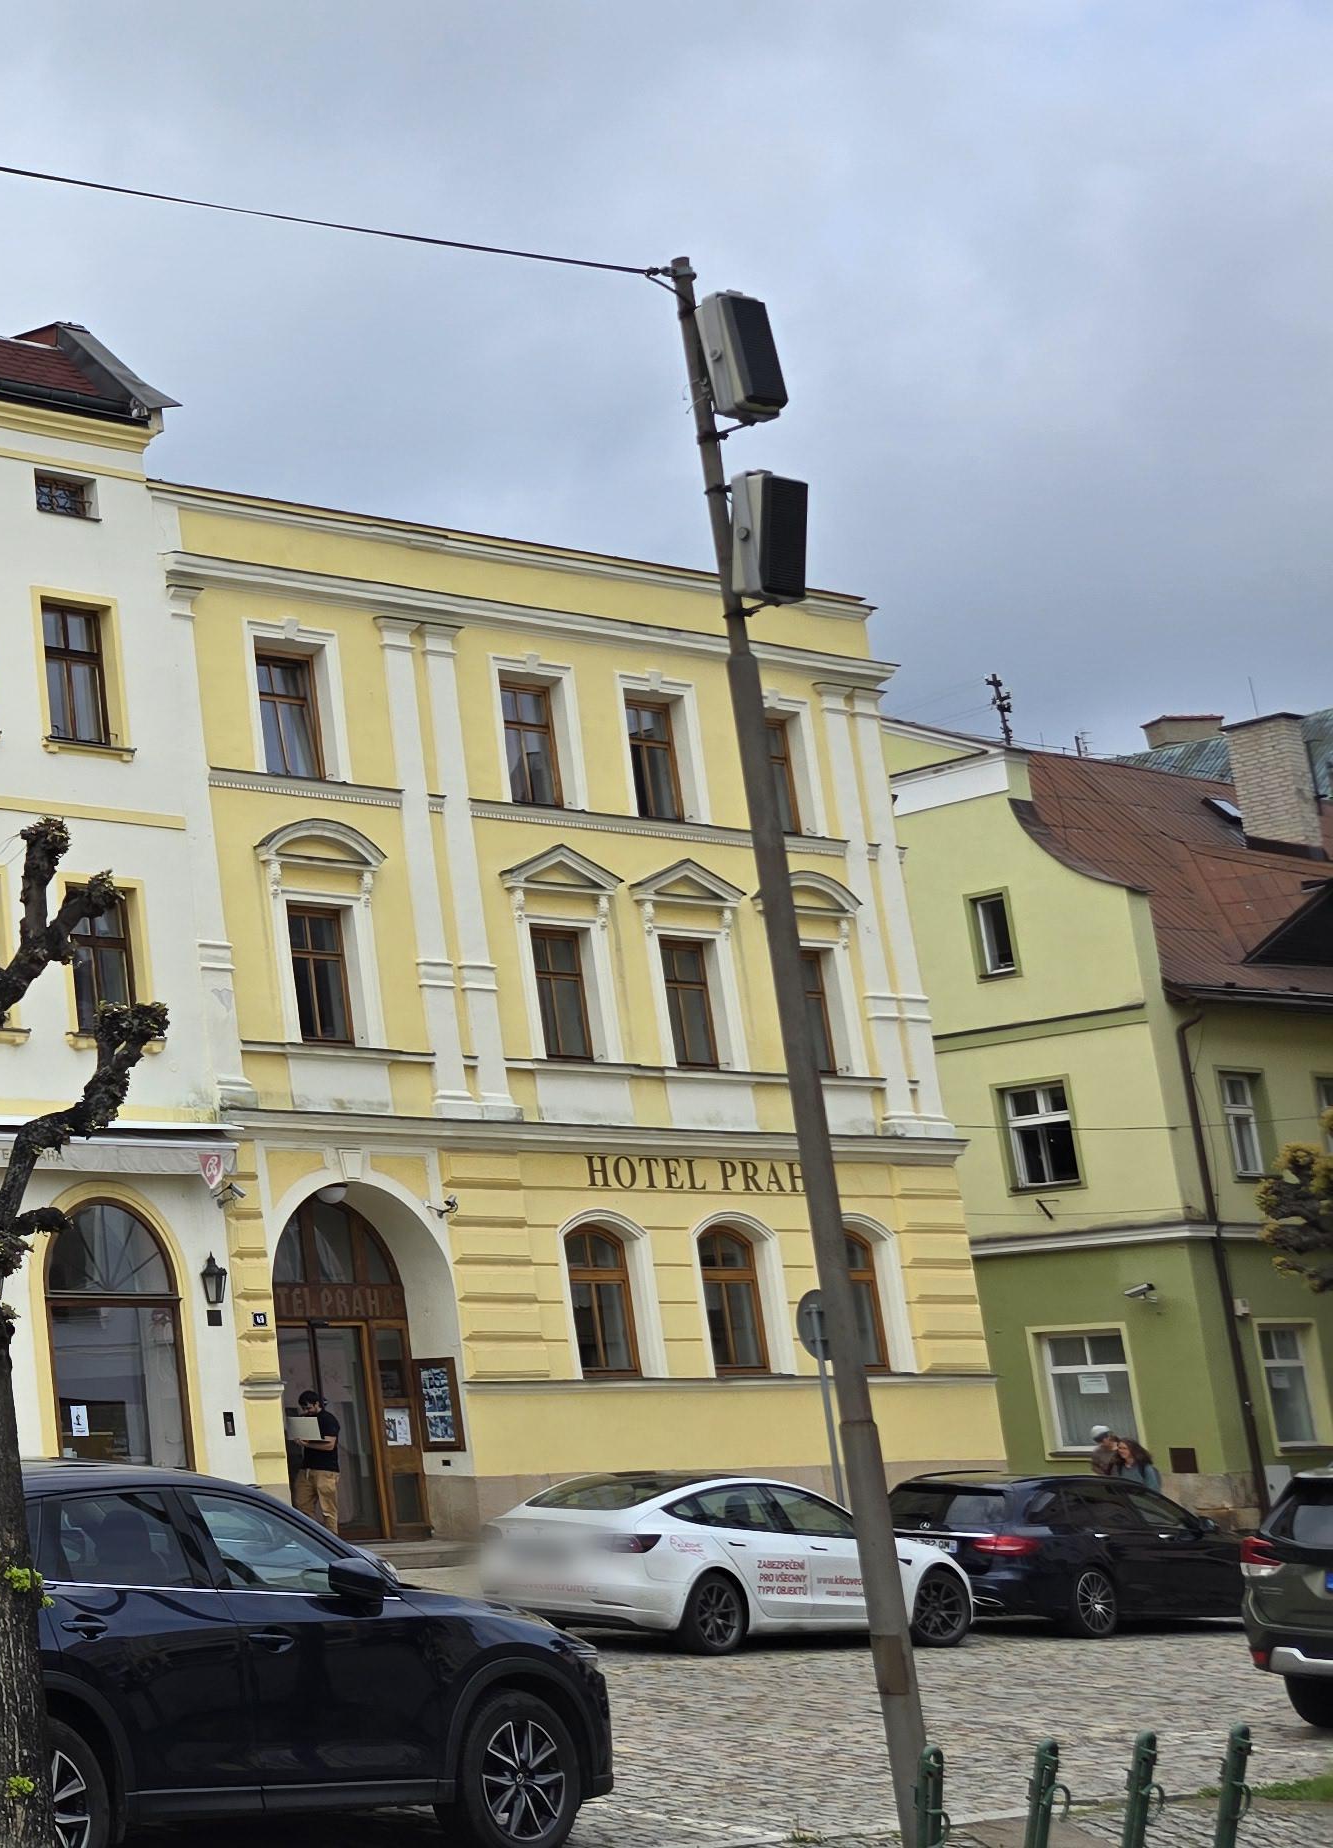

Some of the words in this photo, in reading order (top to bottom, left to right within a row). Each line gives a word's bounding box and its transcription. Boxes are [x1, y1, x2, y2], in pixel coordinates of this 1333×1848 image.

[584, 1155, 707, 1190] HOTEL
[717, 1160, 806, 1193] PRAH
[276, 1287, 316, 1317] TEL
[757, 1559, 805, 1570] ZABEZPEČENÍ
[759, 1573, 774, 1582] PRO
[757, 1585, 775, 1595] TYPY
